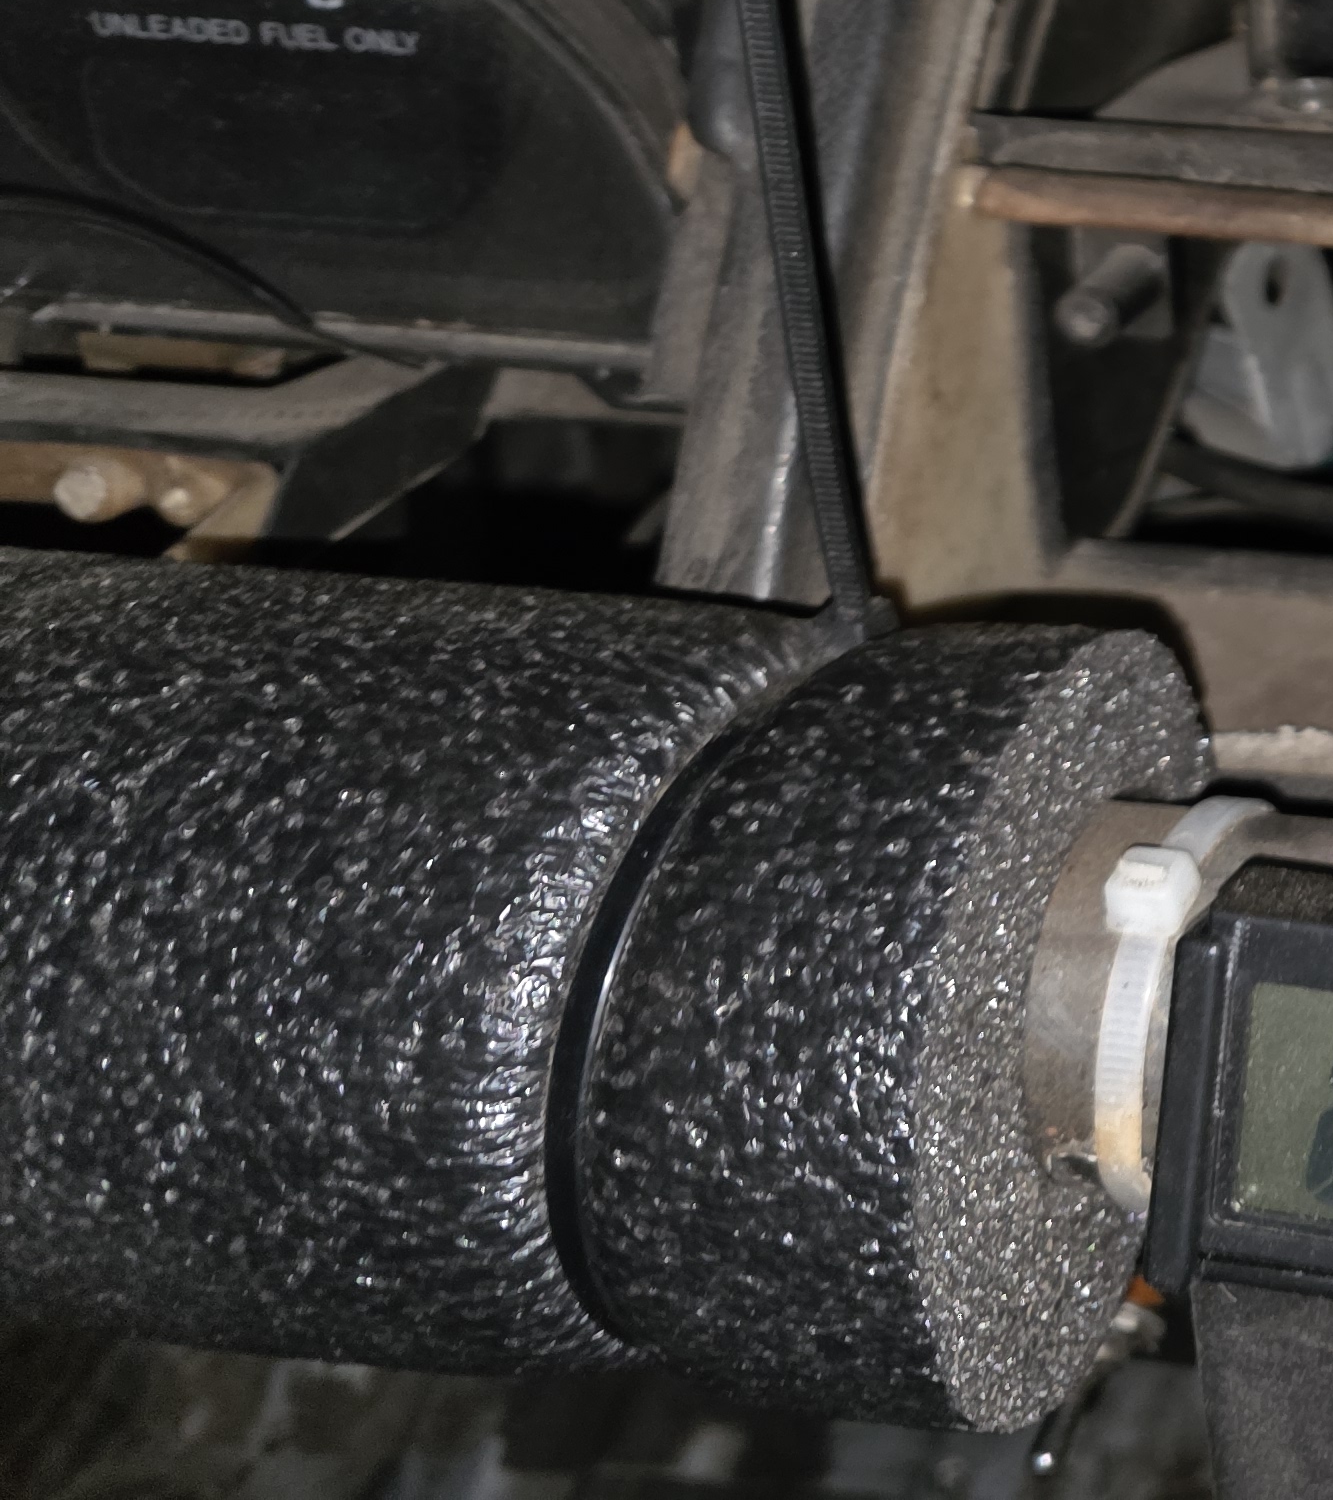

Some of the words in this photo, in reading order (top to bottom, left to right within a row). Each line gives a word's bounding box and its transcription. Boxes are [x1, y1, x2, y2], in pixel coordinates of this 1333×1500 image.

[87, 11, 250, 45] UNLEADED
[259, 20, 339, 51] FUEL
[343, 25, 420, 56] ONLY
